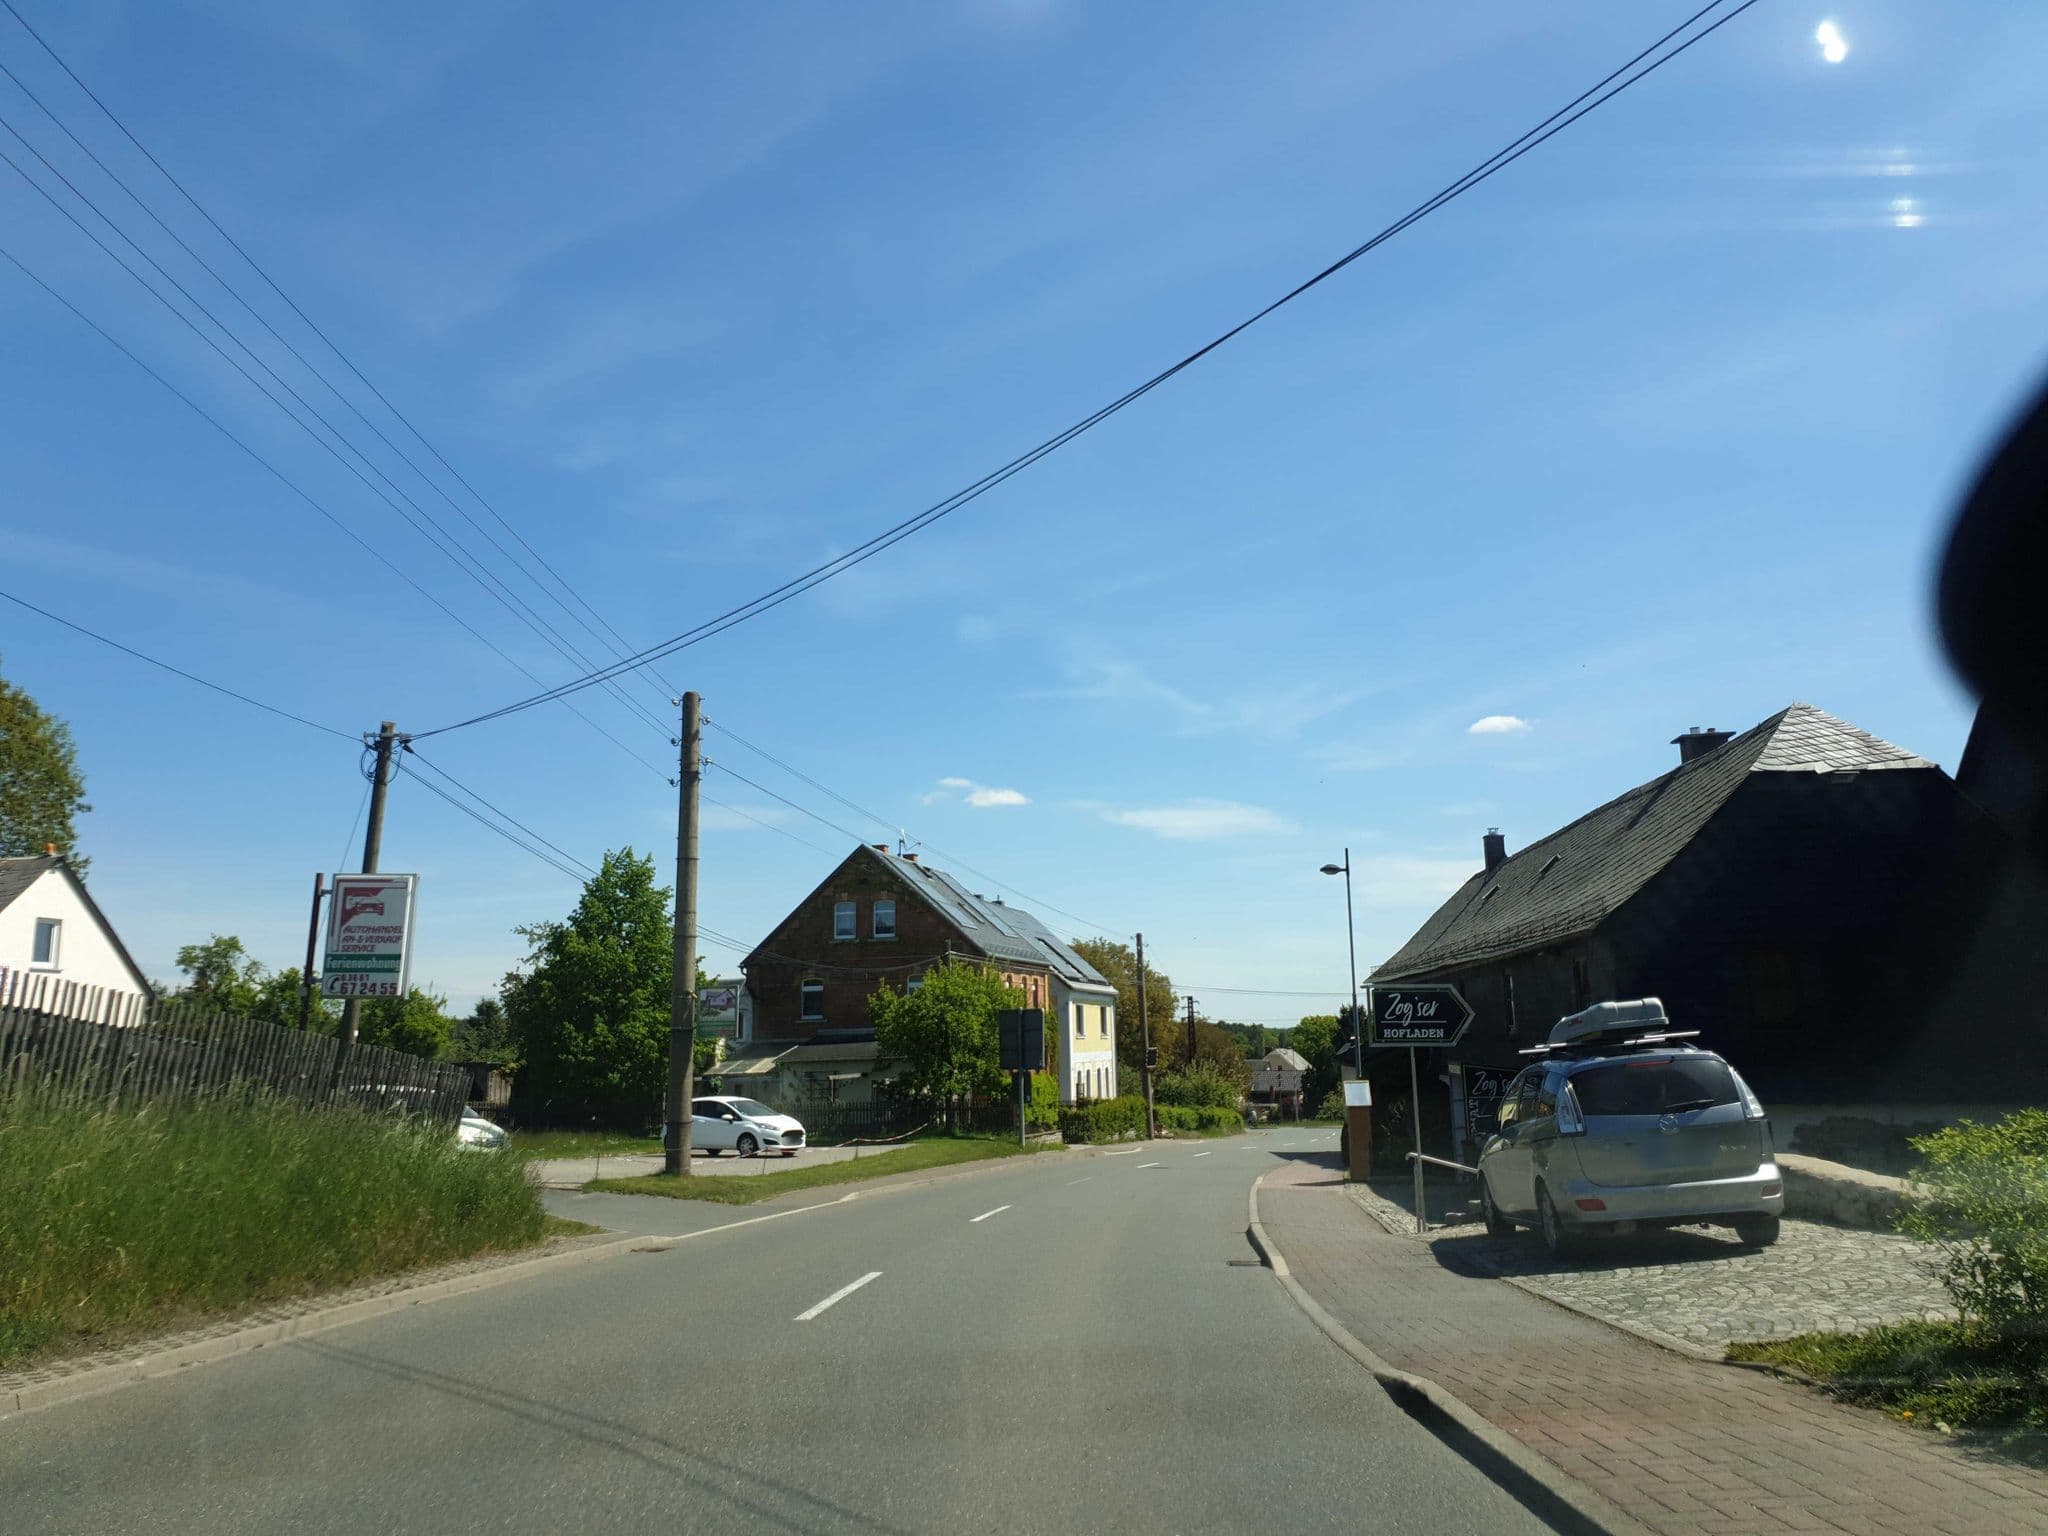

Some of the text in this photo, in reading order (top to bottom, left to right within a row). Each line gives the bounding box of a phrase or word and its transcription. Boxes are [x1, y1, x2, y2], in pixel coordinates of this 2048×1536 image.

[342, 925, 403, 935] AUTOHANDEL
[340, 944, 376, 953] SERVICE
[326, 956, 401, 971] Ferienwohnung
[1383, 1029, 1444, 1038] HOFLADEN
